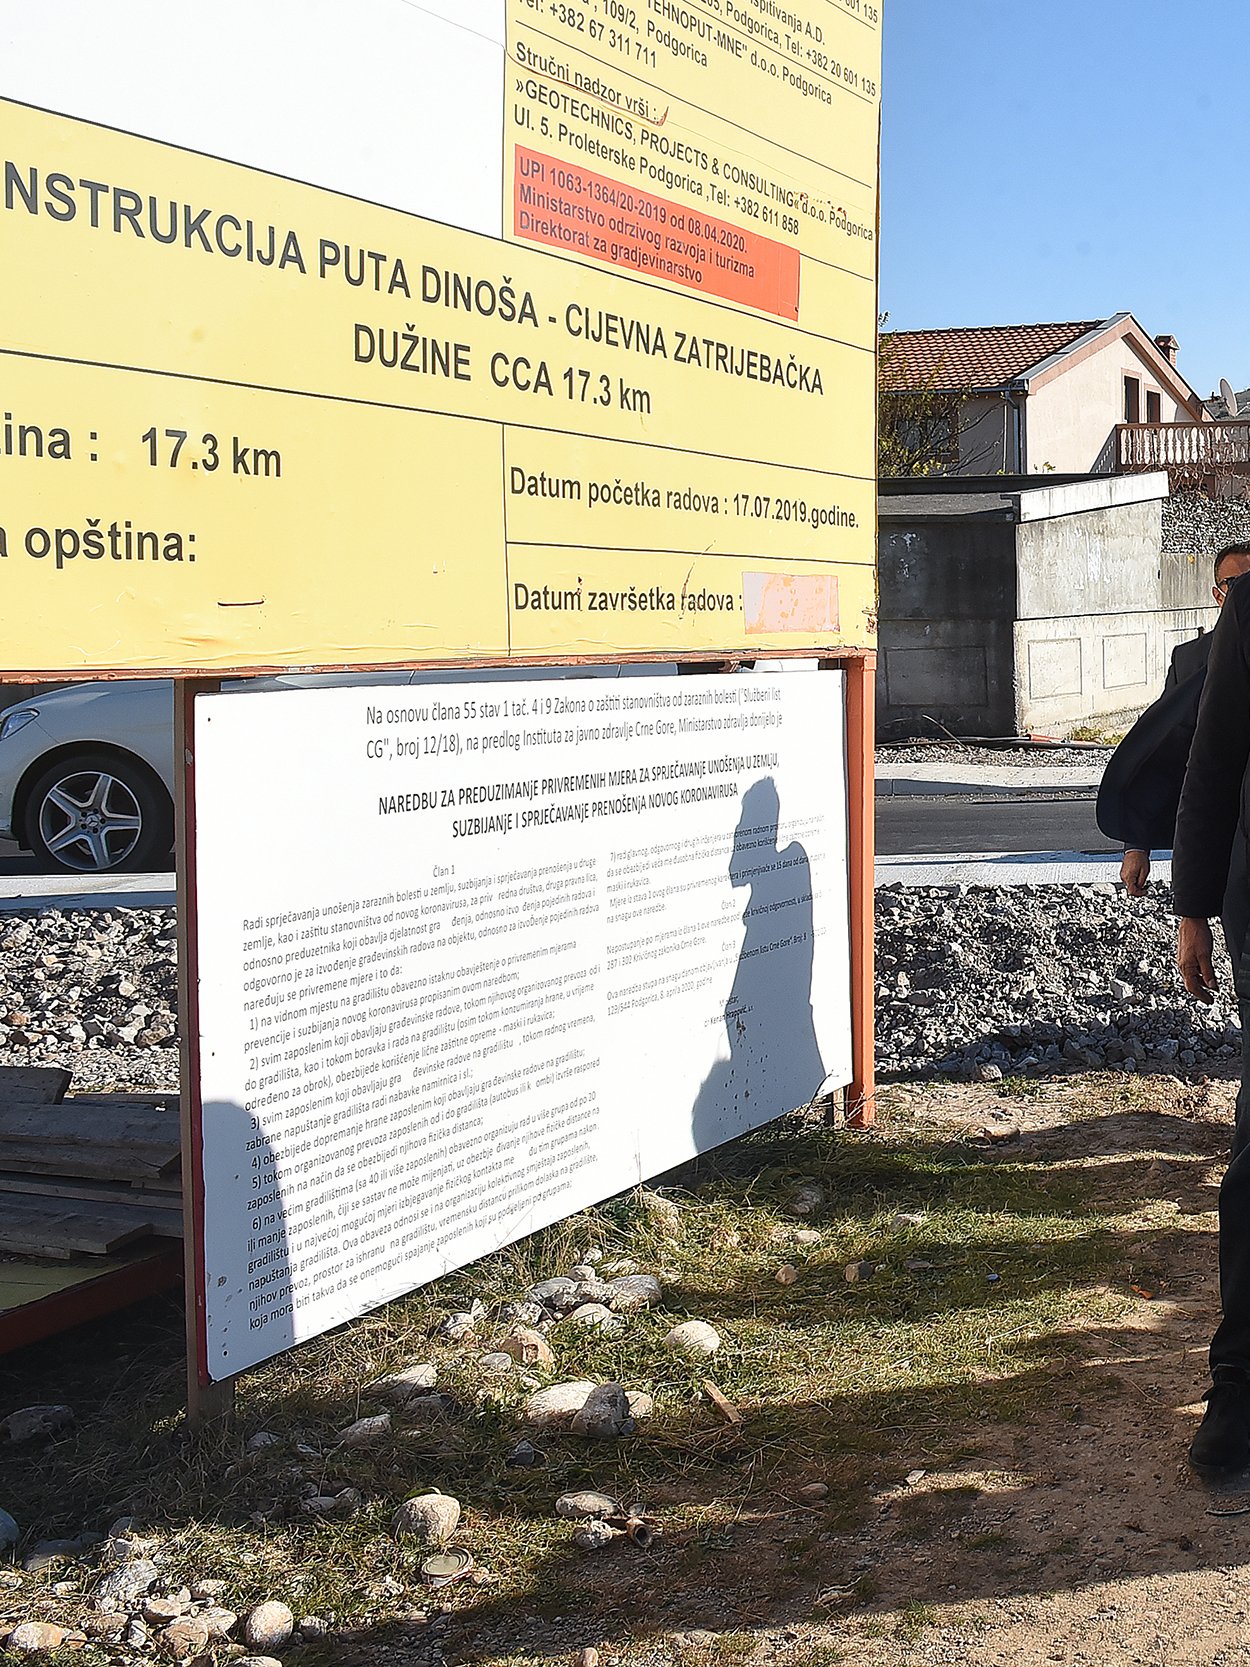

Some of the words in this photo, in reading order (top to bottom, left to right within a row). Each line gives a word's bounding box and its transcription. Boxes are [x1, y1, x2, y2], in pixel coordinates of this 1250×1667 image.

[520, 0, 544, 14] el:
[550, 3, 585, 33] +382
[589, 19, 605, 42] 67
[609, 29, 630, 56] 311
[635, 42, 656, 69] 711
[603, 0, 639, 35] 109/2,
[647, 19, 708, 68] Podgorica
[750, 0, 803, 34] spitivanja
[805, 21, 825, 46] A.D.
[864, 4, 878, 23] 135
[516, 42, 570, 82] Stručni
[575, 72, 622, 105] nadzor
[625, 96, 649, 118] vrši
[726, 0, 782, 50] Podgorica,
[785, 34, 803, 58] Tel:
[806, 49, 828, 72] +382
[831, 60, 842, 78] 20
[843, 67, 858, 88] 601
[861, 77, 876, 97] 135
[750, 50, 780, 79] d.o.o.
[782, 66, 832, 106] Podgorica
[518, 155, 548, 183] UPI
[550, 167, 669, 224] 1063-1364/20-2019
[669, 208, 687, 232] od
[687, 214, 748, 256] 08.04.2020.
[540, 116, 553, 139] 5.
[559, 123, 636, 171] Proleterske
[640, 156, 703, 197] Podgorica
[734, 196, 760, 219] +382
[762, 206, 779, 227] 611
[782, 214, 799, 236] 858
[639, 123, 709, 171] PROJECTS
[711, 158, 720, 176] &
[800, 201, 827, 223] d.o.o.
[829, 211, 873, 241] Podgorica
[519, 179, 608, 228] Ministarstvo
[608, 214, 664, 253] odrzivog
[665, 236, 706, 266] razvoja
[716, 248, 755, 279] turizma
[520, 207, 592, 256] Direktorat
[592, 235, 610, 261] za
[610, 239, 704, 289] gradjevinarstvo
[5, 160, 307, 275] NSTRUKCIJA
[320, 239, 412, 299] PUTA
[422, 265, 539, 329] DINOŠA
[566, 304, 668, 359] CIJEVNA
[674, 331, 824, 396] ZATRIJEBAČKA
[354, 323, 472, 382] DUŽINE
[491, 352, 554, 397] CCA
[563, 367, 612, 407] 17.3
[620, 378, 651, 415] km
[0, 412, 71, 460] ina
[142, 427, 220, 472] 17.3
[232, 437, 281, 478] km
[511, 467, 581, 501] Datum
[589, 479, 661, 509] početka
[667, 487, 720, 514] radova
[25, 518, 196, 569] opština:
[514, 583, 583, 612] Datum
[588, 586, 676, 612] završetka
[681, 585, 734, 612] radova
[367, 706, 383, 725] Na
[386, 708, 429, 724] osnovu
[432, 702, 461, 721] člana
[464, 701, 477, 720] 55
[480, 702, 501, 719] stav
[512, 698, 530, 717] tač.
[531, 699, 538, 715] 4
[545, 698, 552, 715] 9
[554, 696, 586, 714] Zakona
[587, 700, 595, 712] o
[596, 695, 621, 712] zaštiti
[622, 692, 671, 710] stanovništva
[672, 691, 683, 707] od
[684, 689, 713, 707] zaraznih
[714, 689, 737, 705] bolesti
[772, 688, 781, 701] list
[397, 737, 420, 760] broj
[424, 733, 463, 757] 12/18),
[466, 737, 479, 751] na
[482, 730, 521, 754] predlog
[523, 728, 562, 746] Instituta
[564, 730, 574, 743] za
[576, 725, 600, 746] javno
[602, 721, 634, 742] zdravlje
[635, 721, 654, 737] Crne
[656, 719, 677, 736] Gore,
[678, 717, 722, 733] Ministarstvo
[723, 713, 749, 731] zdravlja
[775, 711, 783, 728] je
[379, 791, 438, 816] NAREDBU
[441, 789, 456, 808] ZA
[541, 772, 607, 796] PRIVREMENIH
[608, 769, 638, 787] MJERA
[639, 767, 651, 784] ZA
[745, 756, 752, 770] U
[649, 790, 679, 809] NOVOG
[680, 782, 739, 804] KORONAVIRUSA
[243, 916, 264, 931] Radi
[266, 907, 320, 929] sprječavanja
[322, 900, 360, 917] unošenja
[362, 893, 395, 909] zaraznih
[396, 888, 422, 903] bolesti
[422, 889, 429, 898] u
[430, 883, 457, 896] zemlju,
[458, 876, 492, 891] suzbijanja
[497, 867, 538, 885] sprječavanja
[539, 861, 573, 878] prenošenja
[579, 858, 596, 869] druge
[244, 992, 285, 1012] naređuju
[287, 991, 297, 1002] se
[299, 979, 348, 1001] privremene
[350, 973, 374, 987] mjere
[380, 969, 389, 979] to
[390, 965, 403, 977] da:
